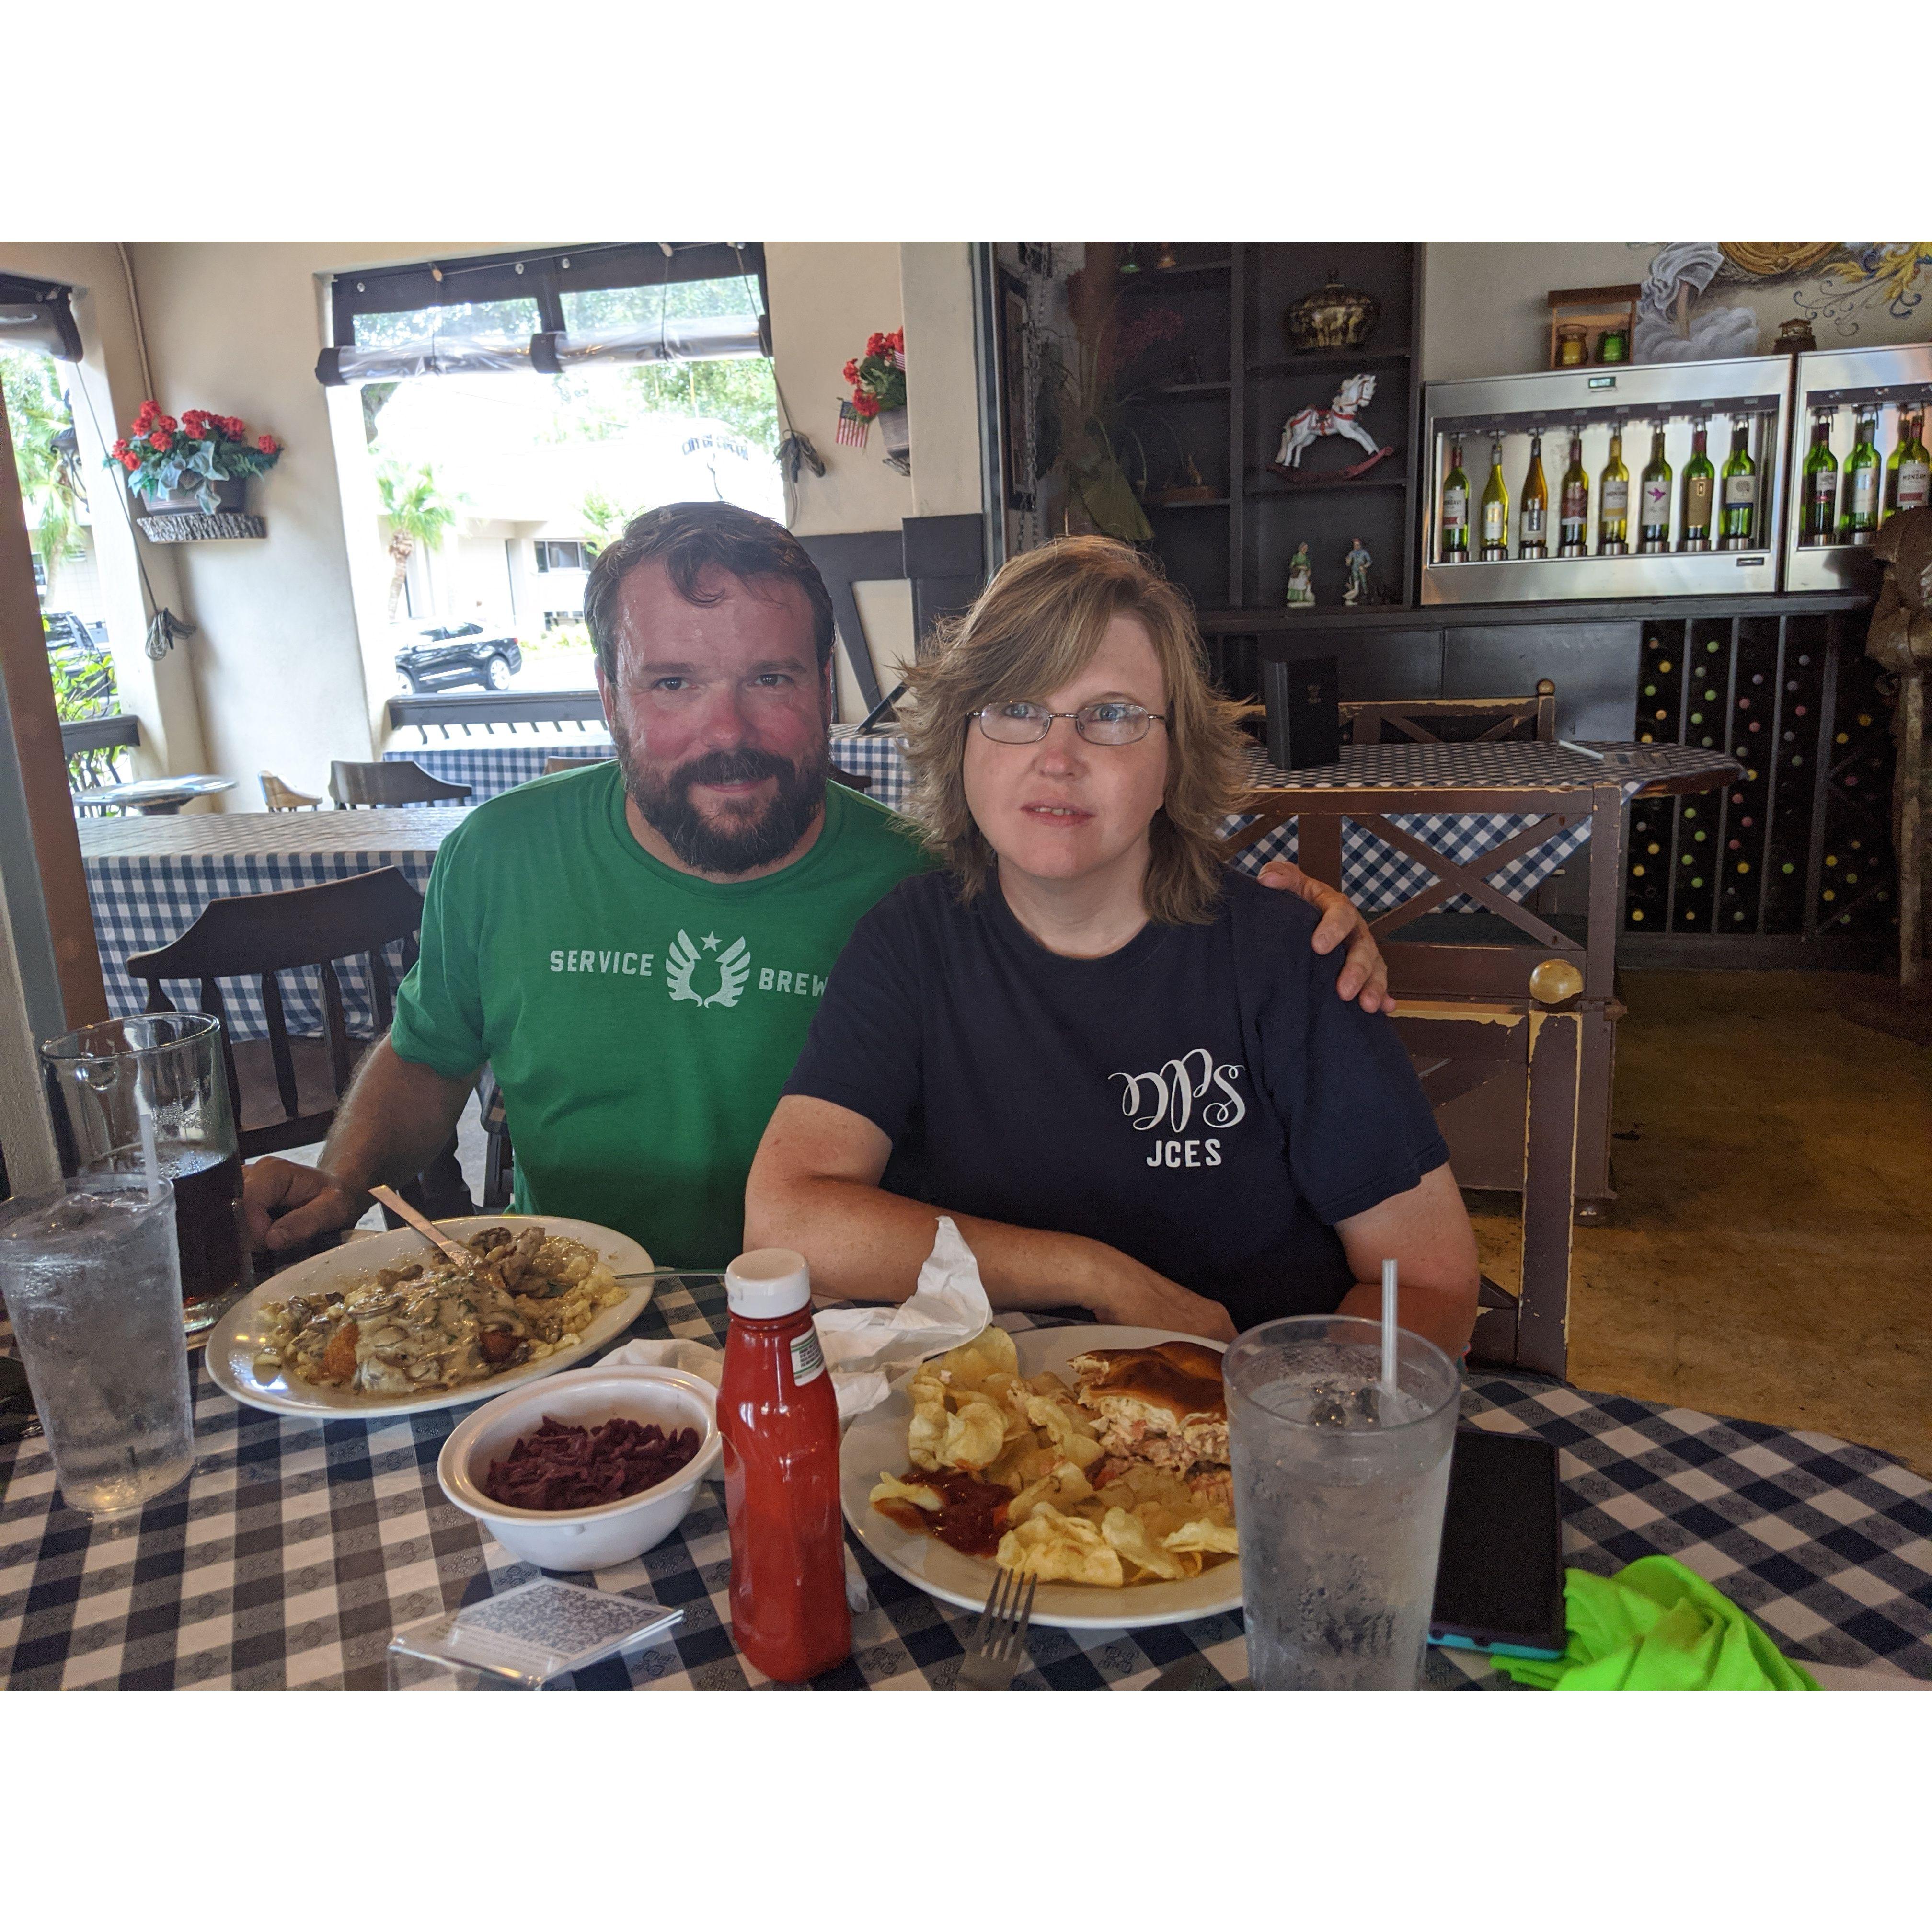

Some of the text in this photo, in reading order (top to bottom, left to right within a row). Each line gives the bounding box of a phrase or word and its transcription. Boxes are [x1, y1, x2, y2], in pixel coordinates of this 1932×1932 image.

[550, 950, 828, 996] SERVICE BREW
[1146, 1139, 1222, 1168] JCES
